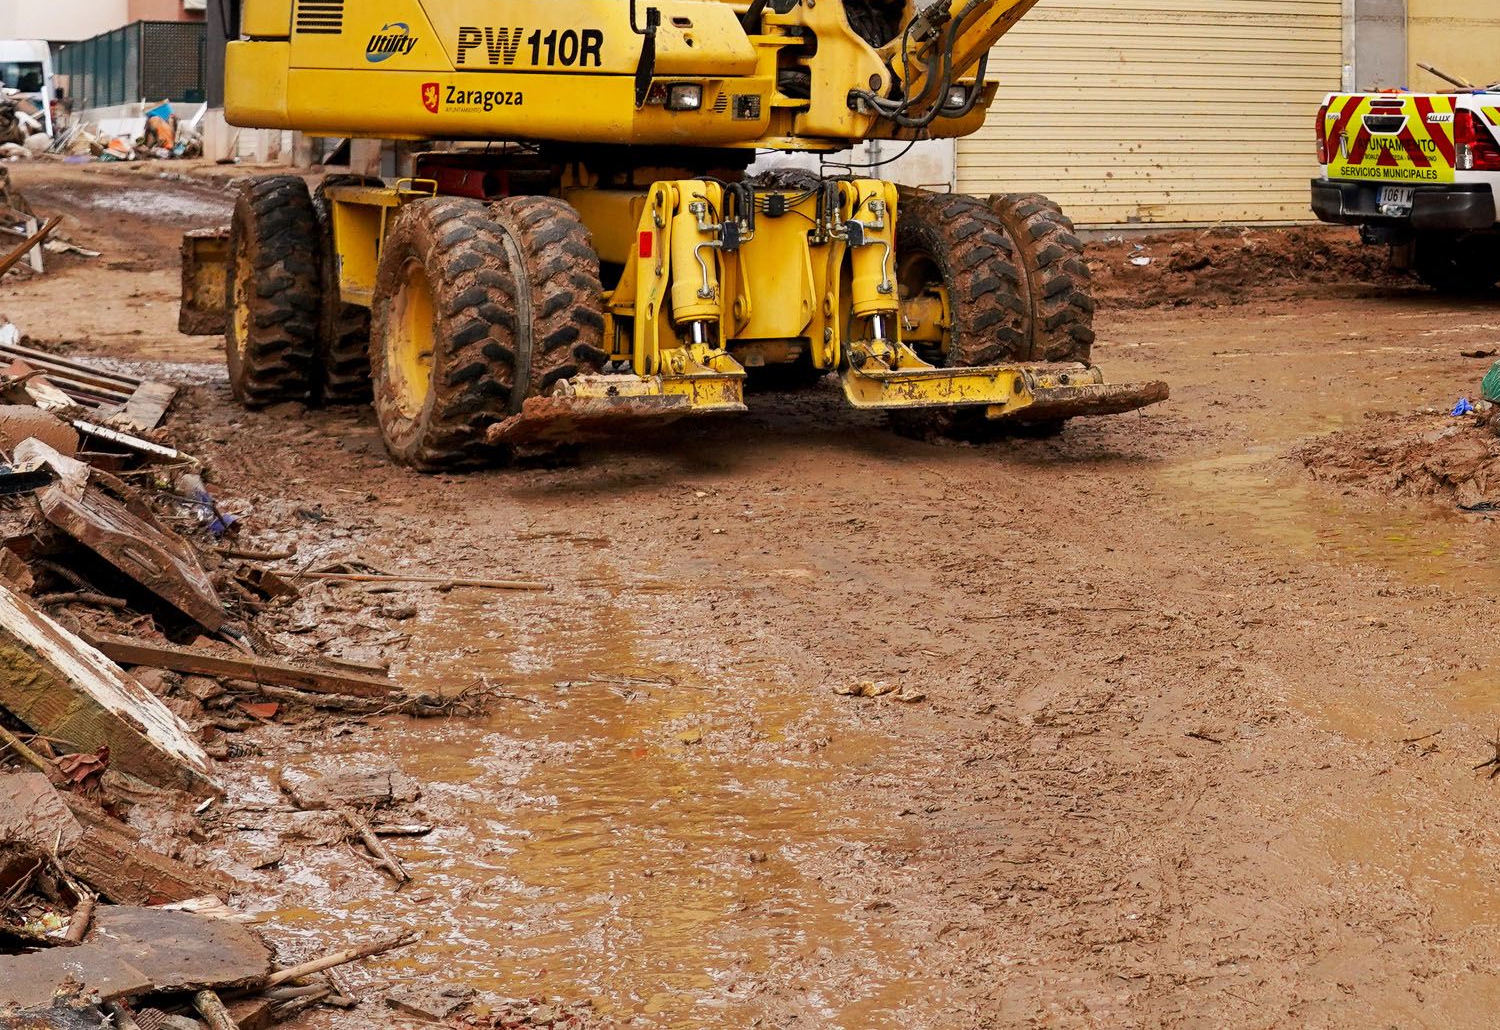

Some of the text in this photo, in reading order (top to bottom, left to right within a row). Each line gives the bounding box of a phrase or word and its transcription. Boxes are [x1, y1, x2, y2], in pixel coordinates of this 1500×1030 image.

[366, 34, 418, 55] Utility
[457, 26, 604, 67] PW 110R
[445, 85, 523, 112] Zaragoza
[1426, 114, 1451, 122] HILUX
[1340, 166, 1437, 179] SERVICIOS MUNICIPALES
[1383, 189, 1404, 202] 1061
